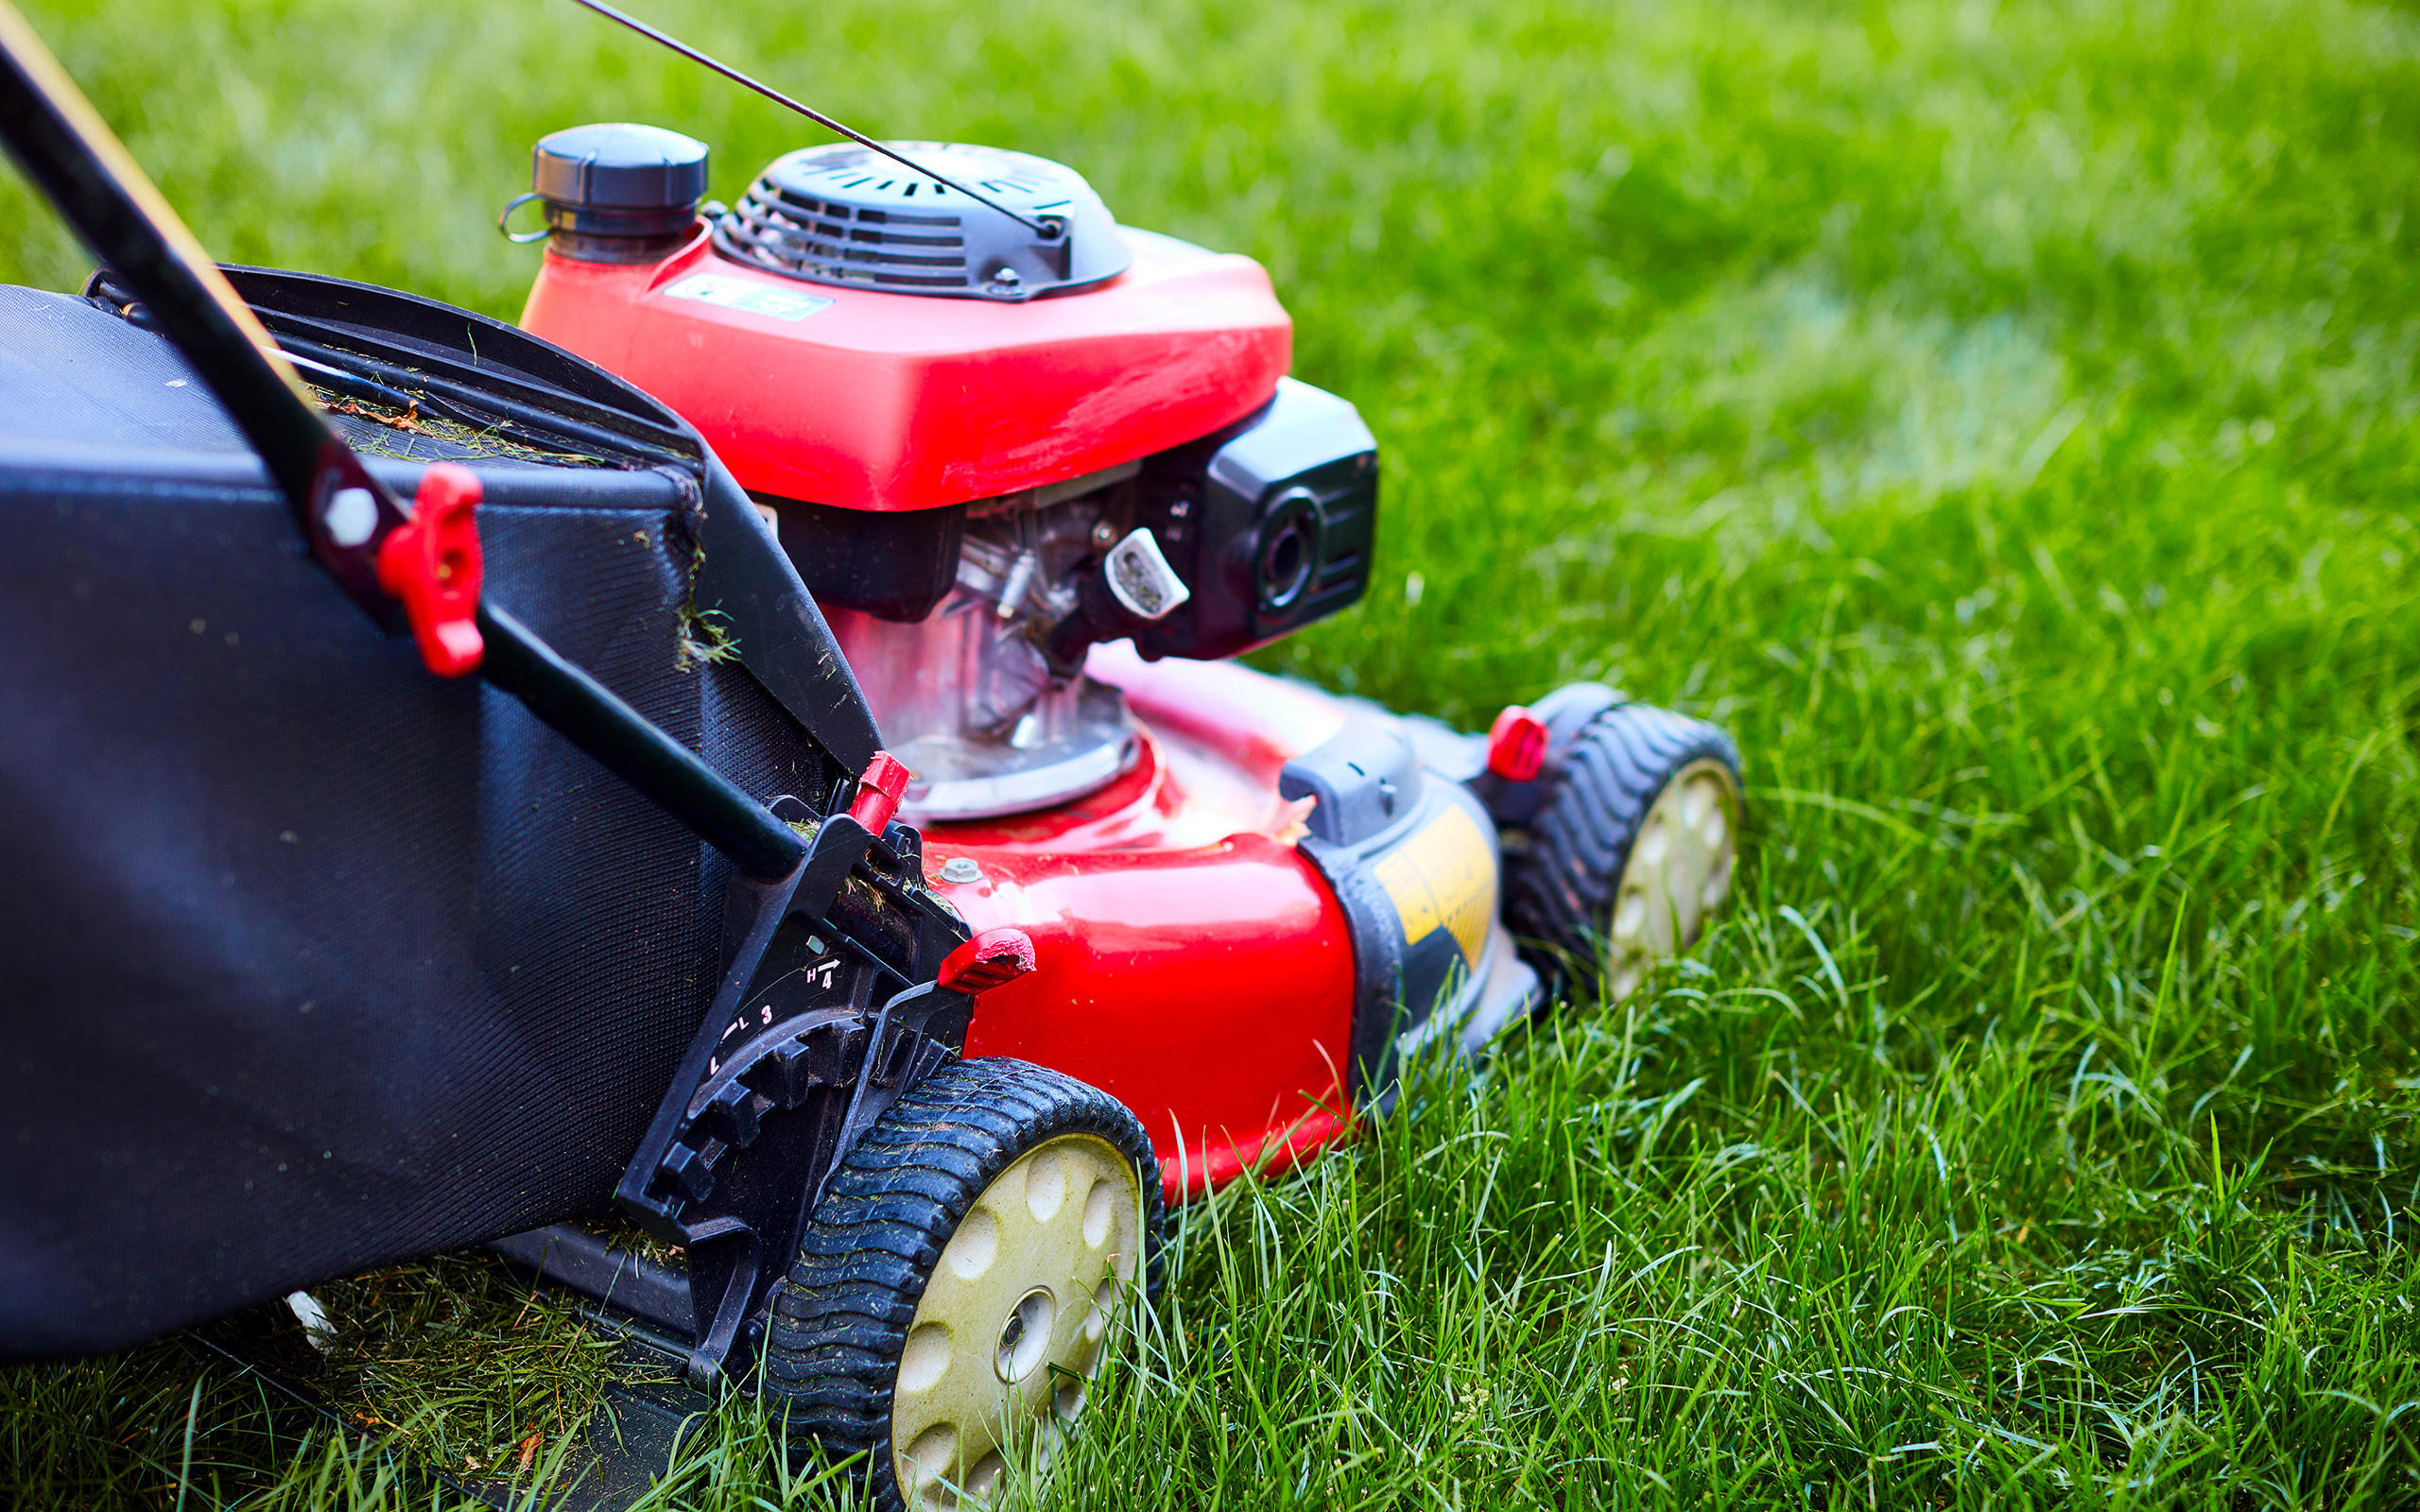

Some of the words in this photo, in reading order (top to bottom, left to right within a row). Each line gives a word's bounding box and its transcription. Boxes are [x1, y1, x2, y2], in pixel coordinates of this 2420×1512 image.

[806, 968, 817, 984] H
[822, 971, 832, 989] 4
[761, 1005, 772, 1025] 3
